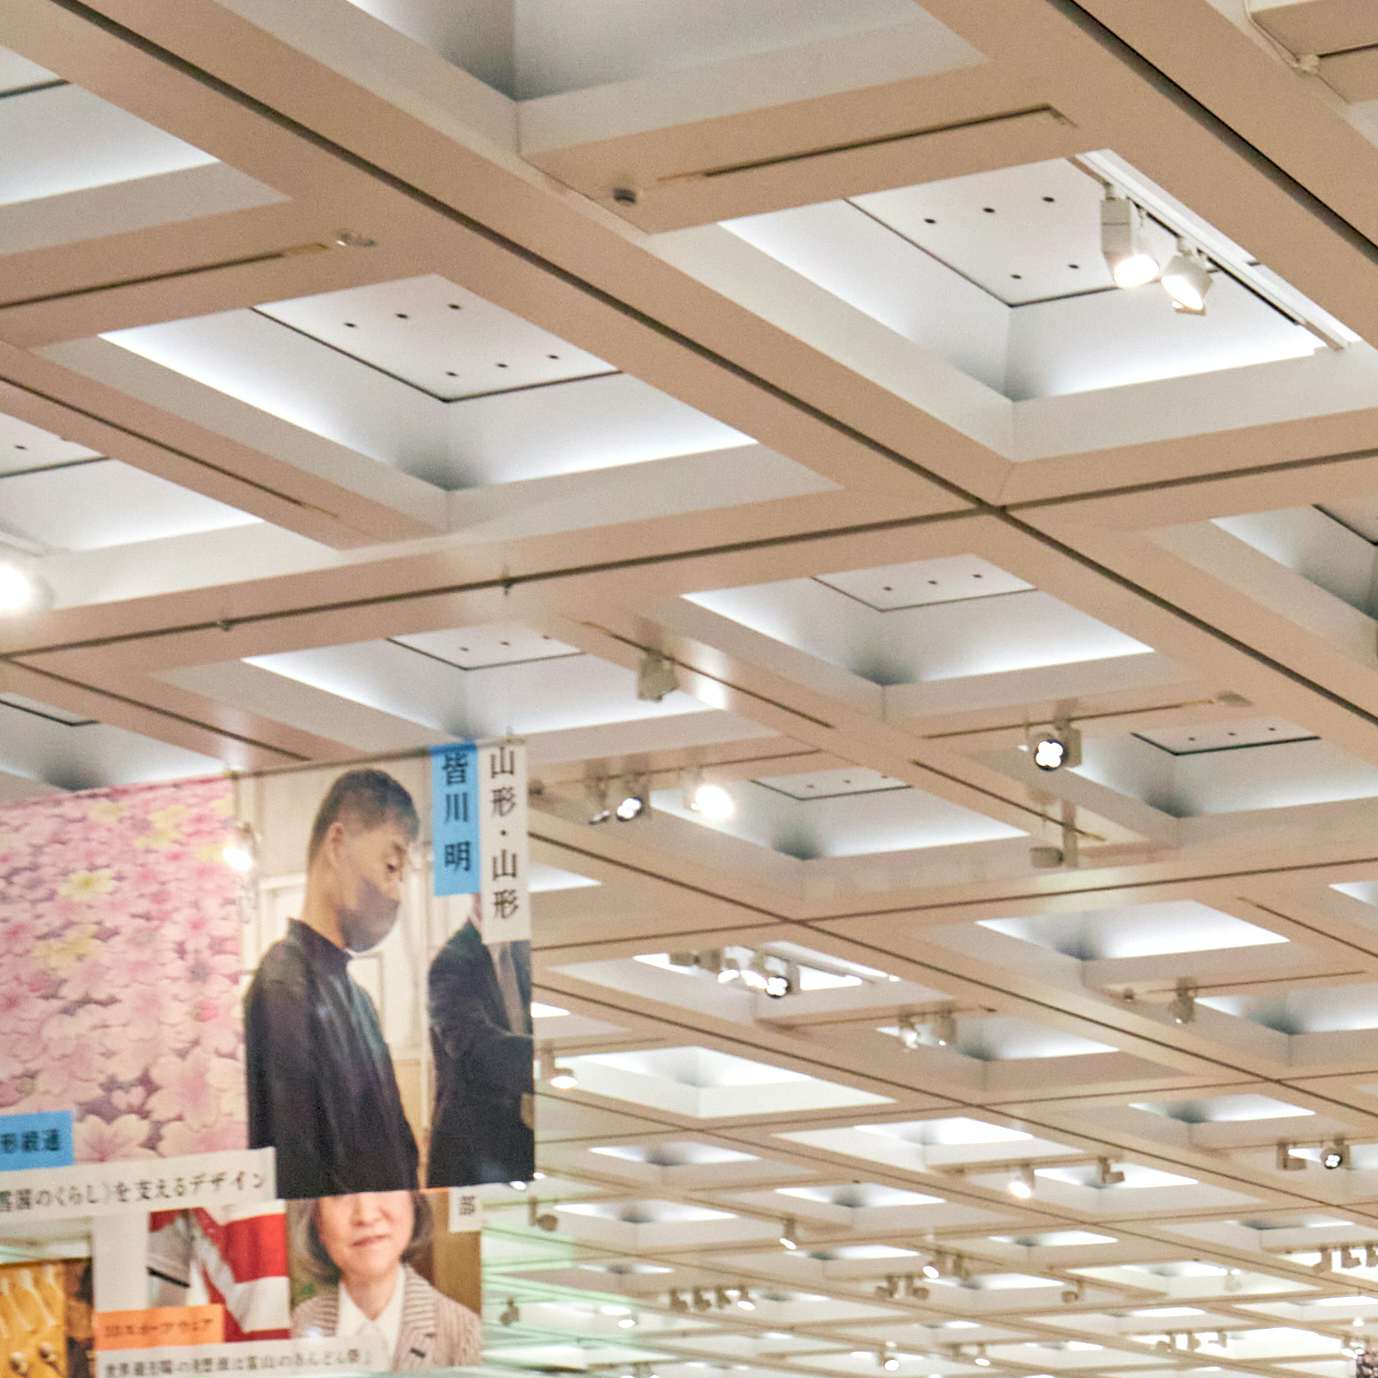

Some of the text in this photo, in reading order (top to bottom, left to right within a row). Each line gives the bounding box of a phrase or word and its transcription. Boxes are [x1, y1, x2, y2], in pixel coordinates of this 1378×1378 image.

[491, 746, 519, 919] 山形・山形
